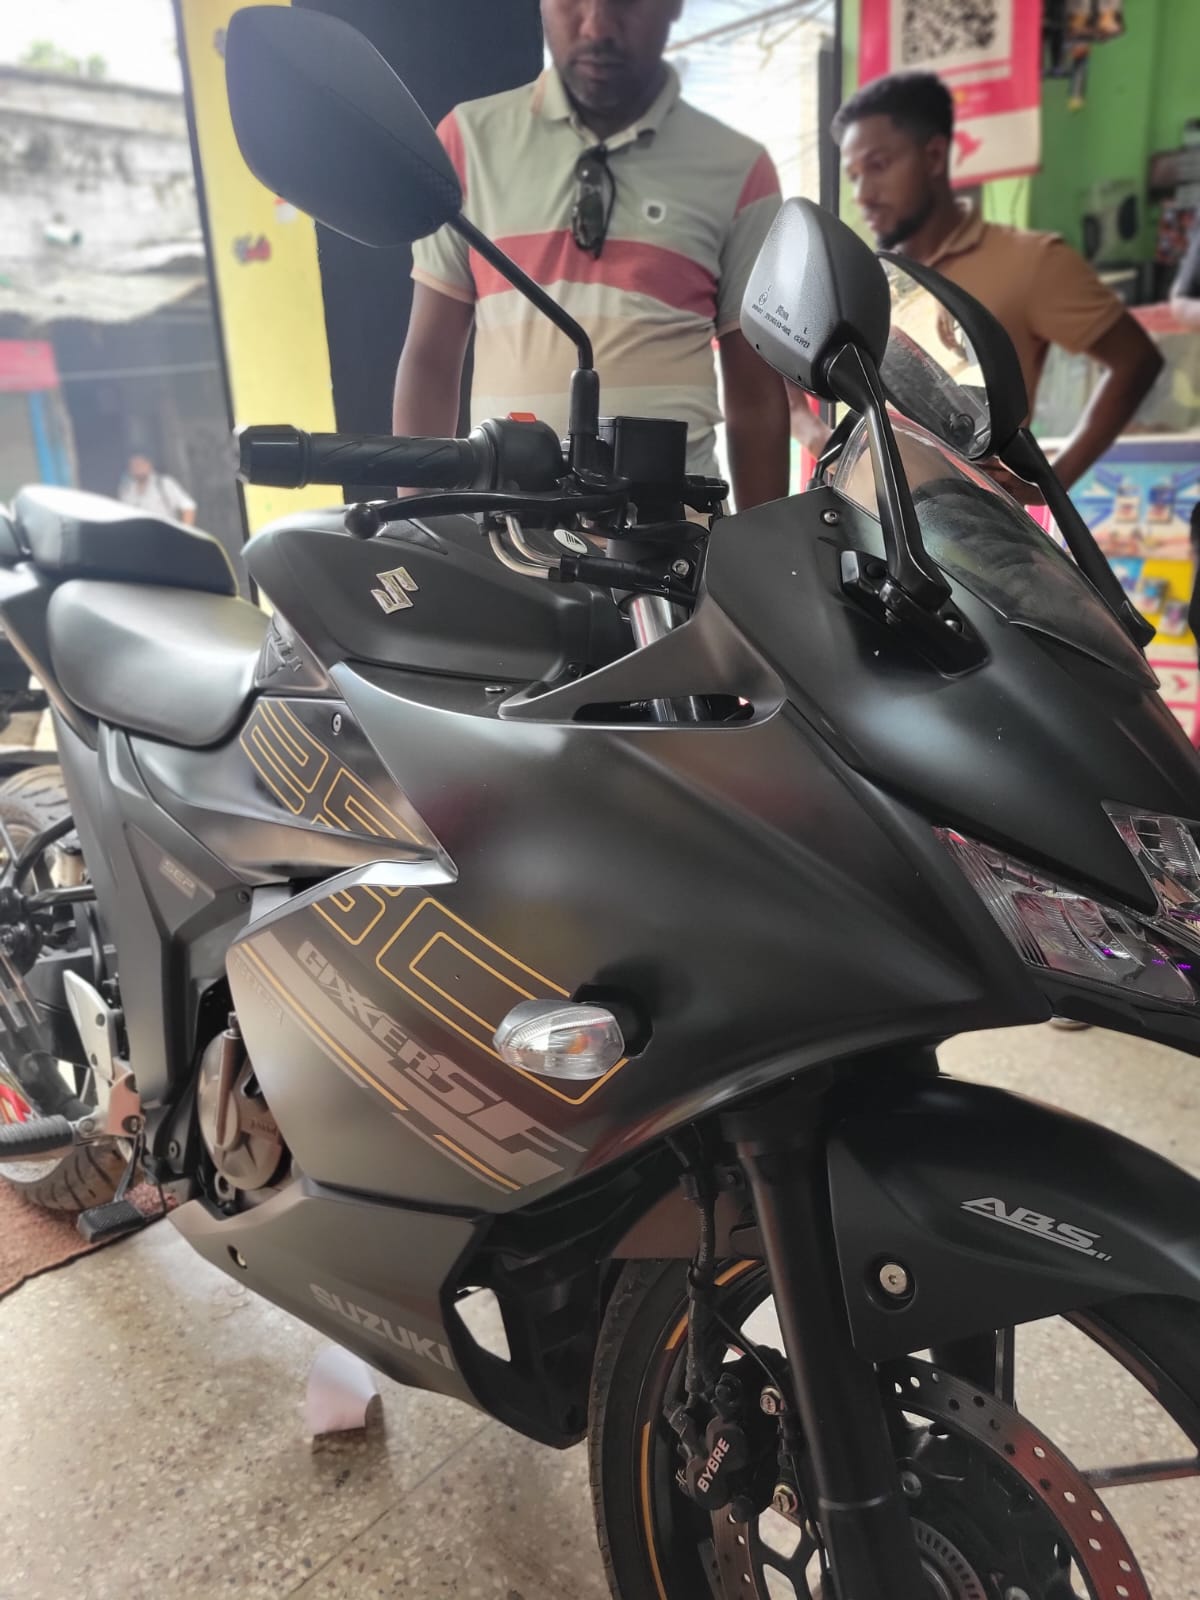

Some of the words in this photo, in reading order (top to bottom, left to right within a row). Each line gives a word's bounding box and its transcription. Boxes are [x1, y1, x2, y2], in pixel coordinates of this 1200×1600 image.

[960, 1197, 1102, 1249] ABS
[309, 1282, 456, 1372] SUZUKI
[697, 1437, 730, 1493] BYBRE
